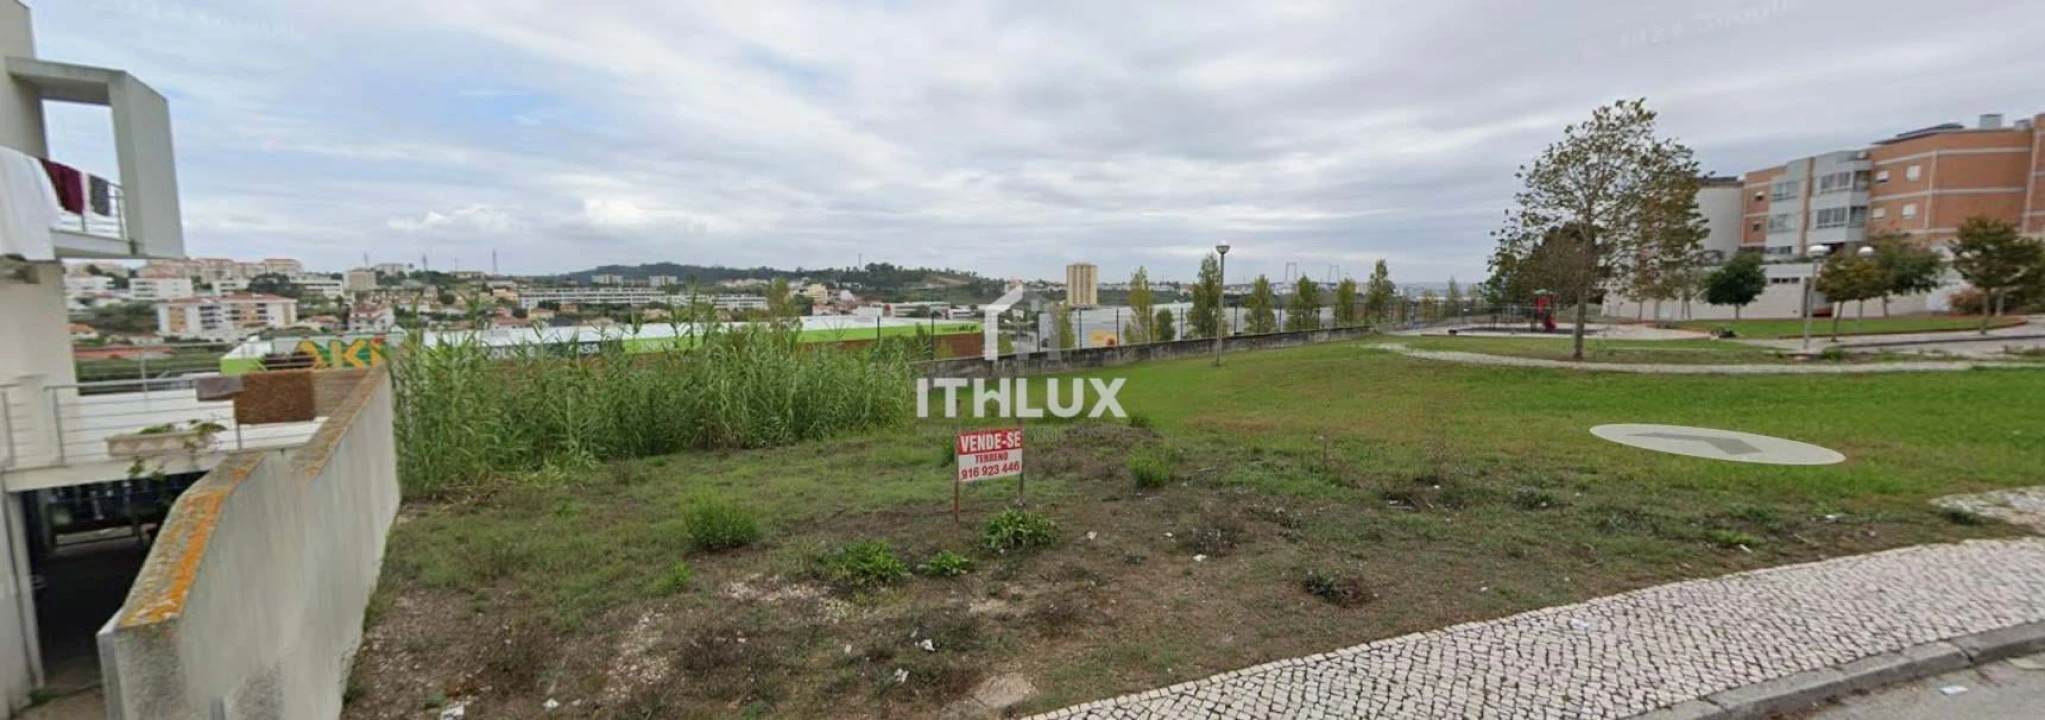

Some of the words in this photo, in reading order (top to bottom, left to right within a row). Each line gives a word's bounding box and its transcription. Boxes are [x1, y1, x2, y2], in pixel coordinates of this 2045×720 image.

[959, 431, 1021, 453] VENDE-SE
[961, 467, 979, 479] 916
[982, 464, 999, 476] 923
